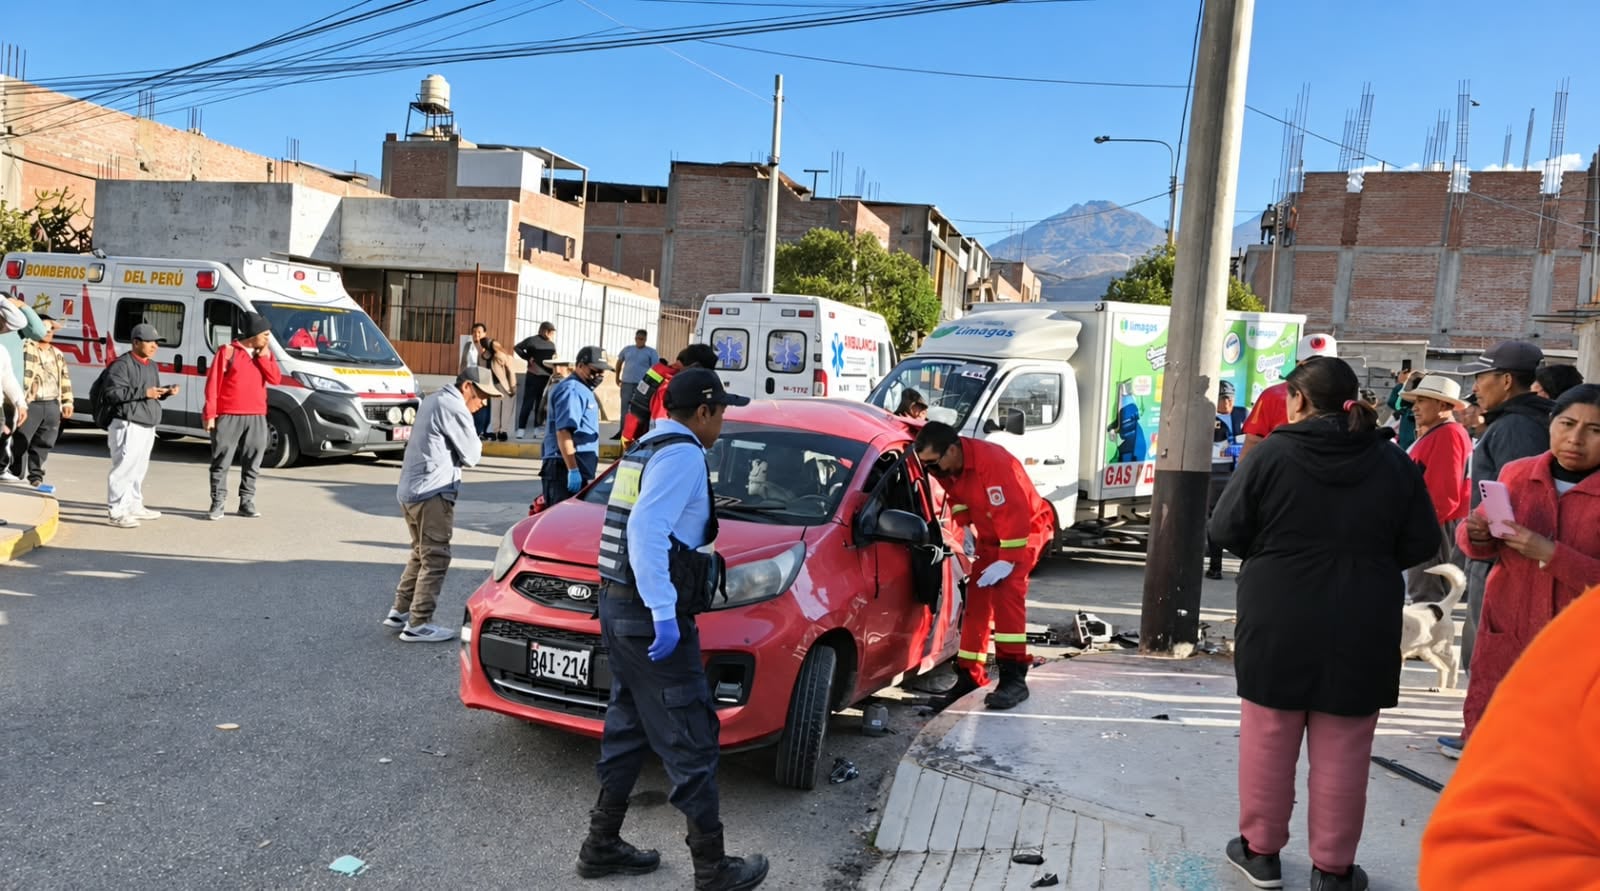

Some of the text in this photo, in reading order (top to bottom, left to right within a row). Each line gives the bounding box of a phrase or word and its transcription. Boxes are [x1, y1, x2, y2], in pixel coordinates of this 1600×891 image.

[25, 264, 87, 280] BOMBEROS
[124, 268, 184, 287] DEL PERÚ
[844, 335, 877, 352] AMBULANCIA
[1105, 464, 1133, 486] GAS
[569, 586, 591, 599] KIA
